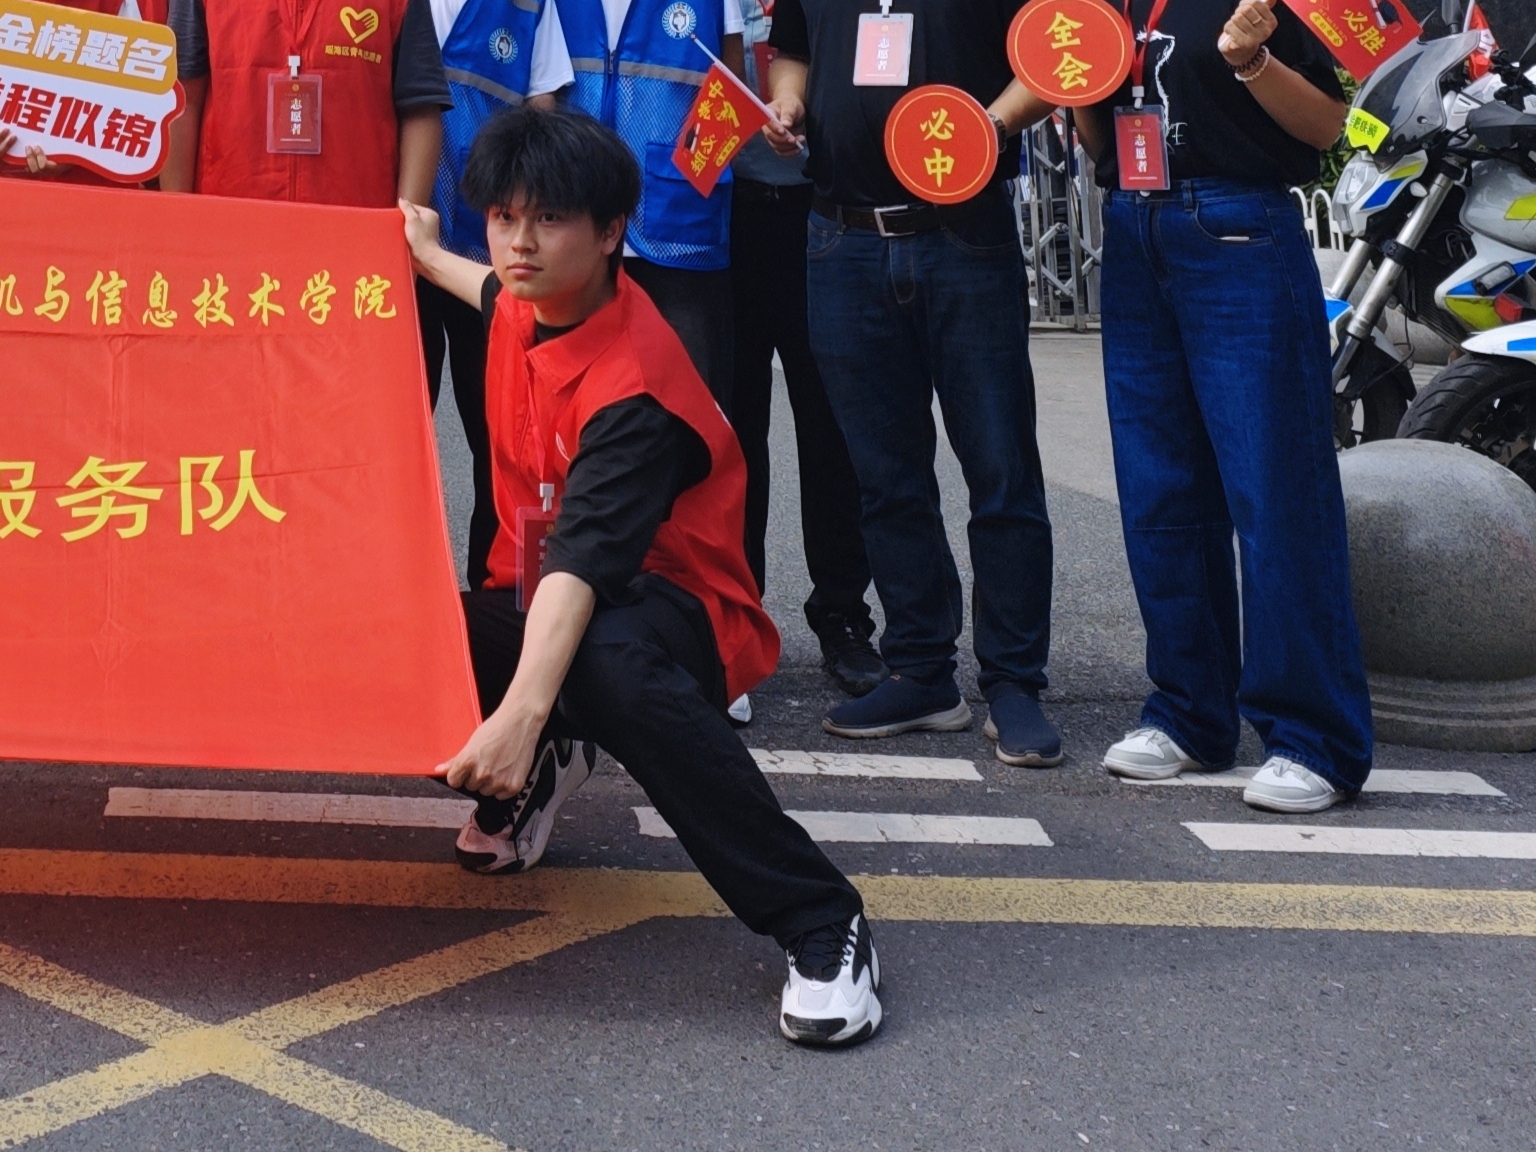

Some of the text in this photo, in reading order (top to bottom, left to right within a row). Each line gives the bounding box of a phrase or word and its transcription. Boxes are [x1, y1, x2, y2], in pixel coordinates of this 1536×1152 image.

[877, 38, 890, 70] 志愿者
[1044, 12, 1092, 90] 全会
[1340, 8, 1386, 57] 必胜
[290, 98, 302, 135] 志愿者
[920, 108, 955, 188] 必中
[1135, 133, 1147, 173] 志愿者
